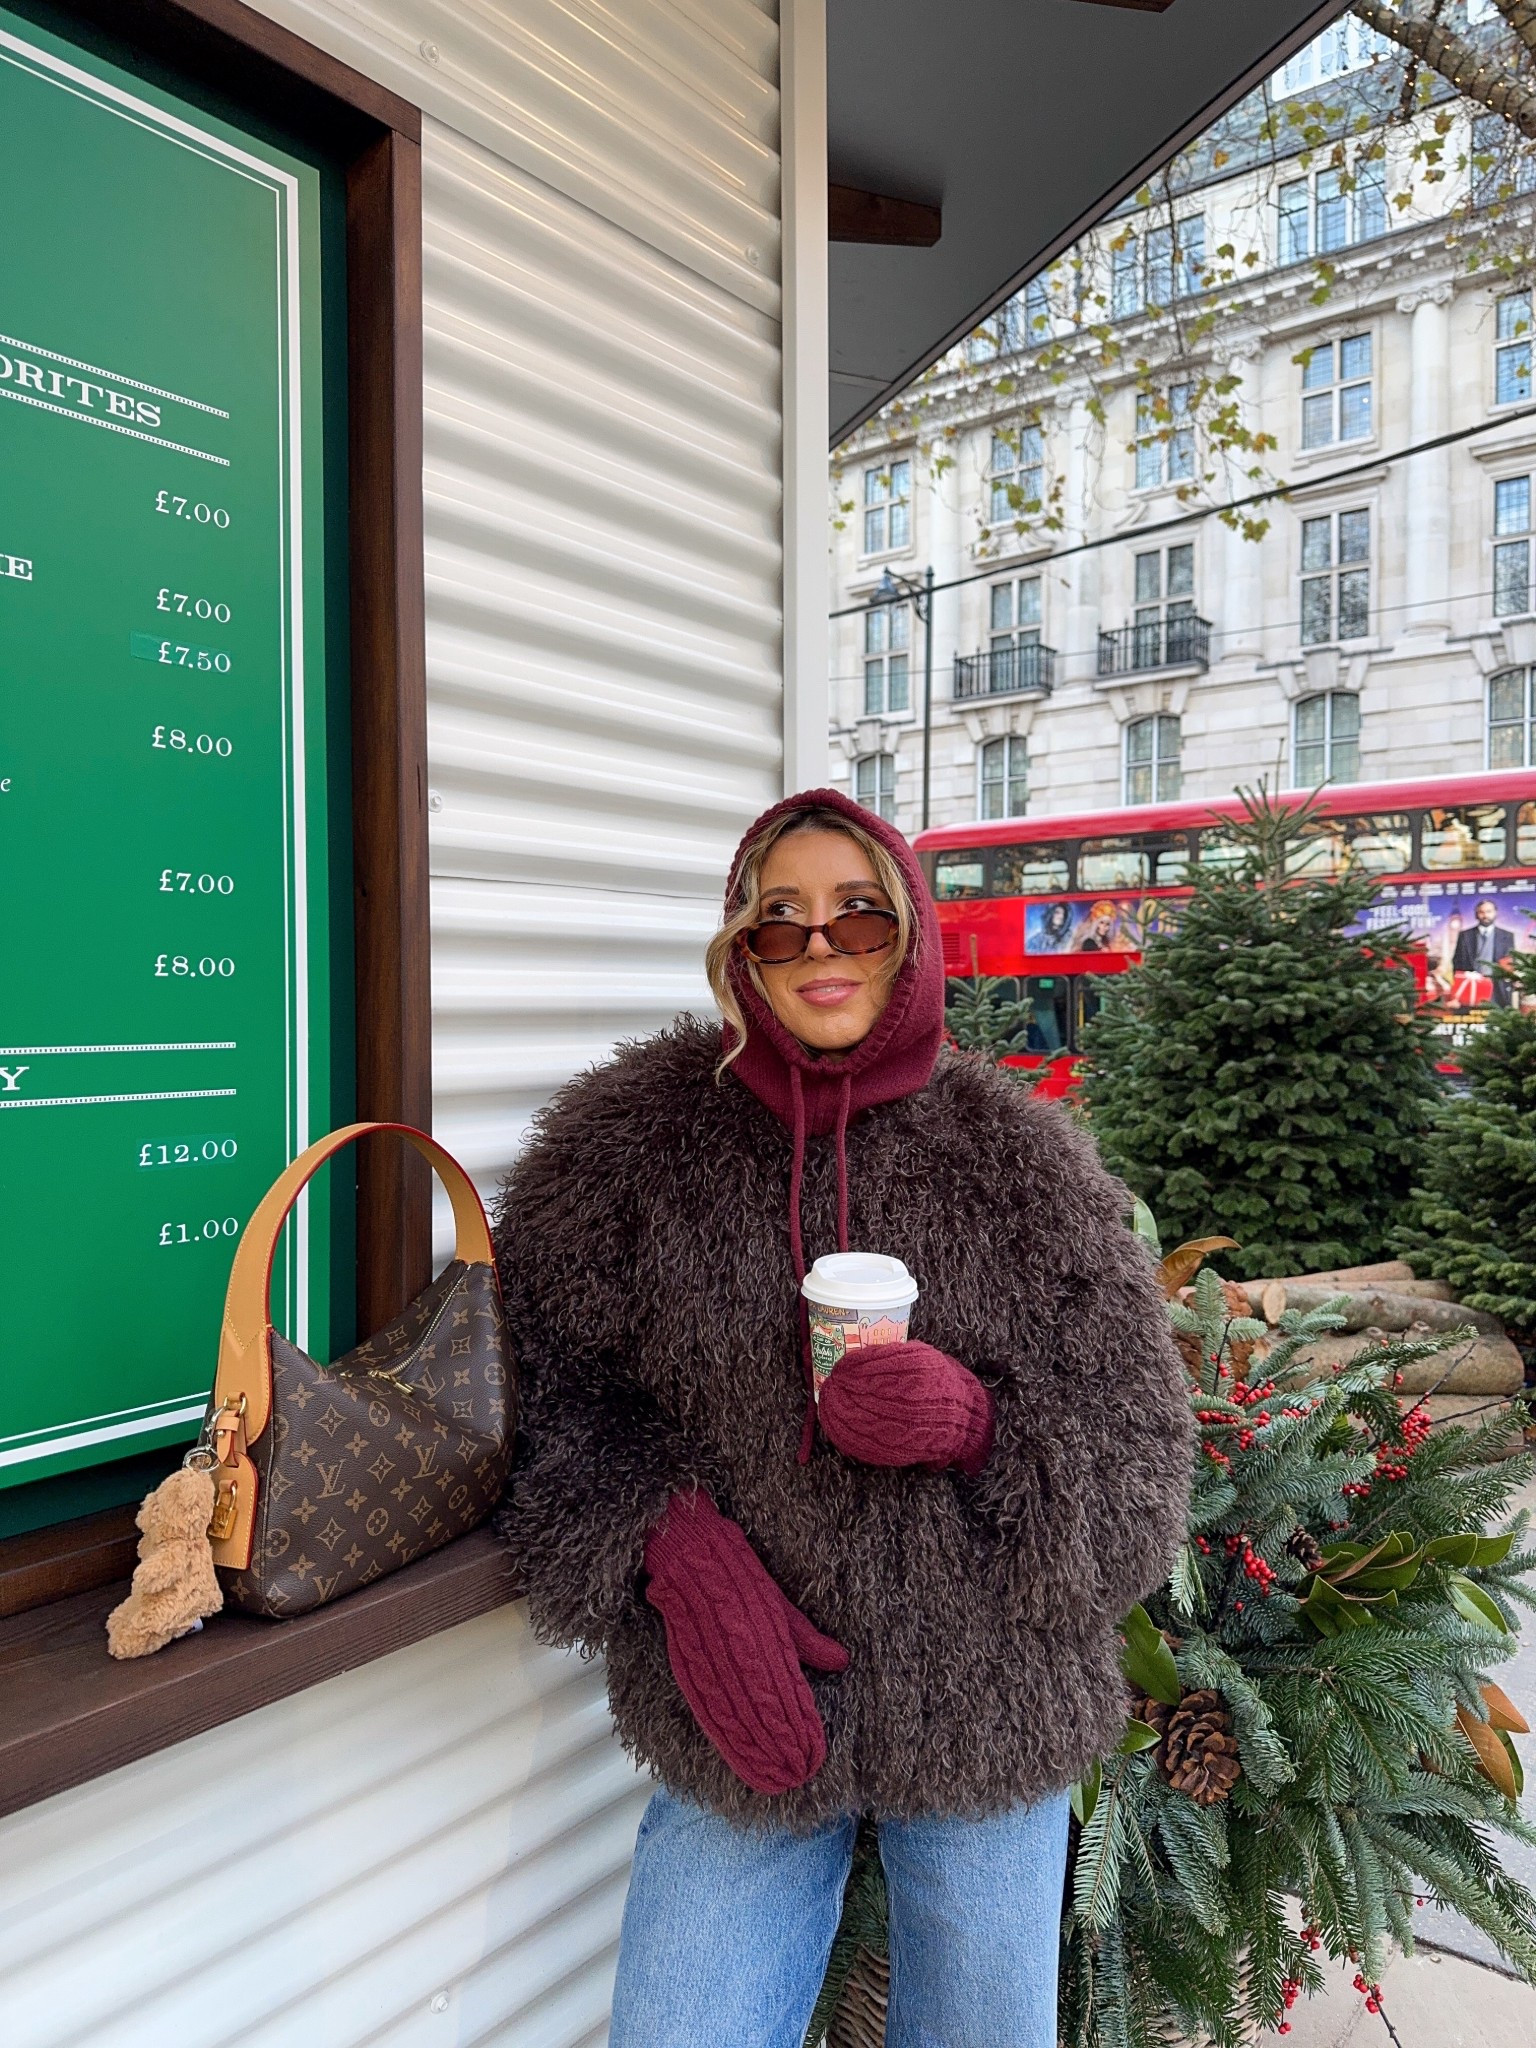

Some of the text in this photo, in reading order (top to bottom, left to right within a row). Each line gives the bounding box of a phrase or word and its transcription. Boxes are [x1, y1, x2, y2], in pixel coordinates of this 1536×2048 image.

[156, 491, 229, 528] £7.00
[0, 553, 33, 581] E
[157, 589, 230, 622] £7.00
[159, 642, 231, 672] £7.50
[152, 726, 232, 756] £8.00
[160, 869, 234, 894] £7.00
[155, 954, 235, 977] £8.00
[140, 1140, 237, 1166] £12.00
[159, 1217, 239, 1246] £1.00
